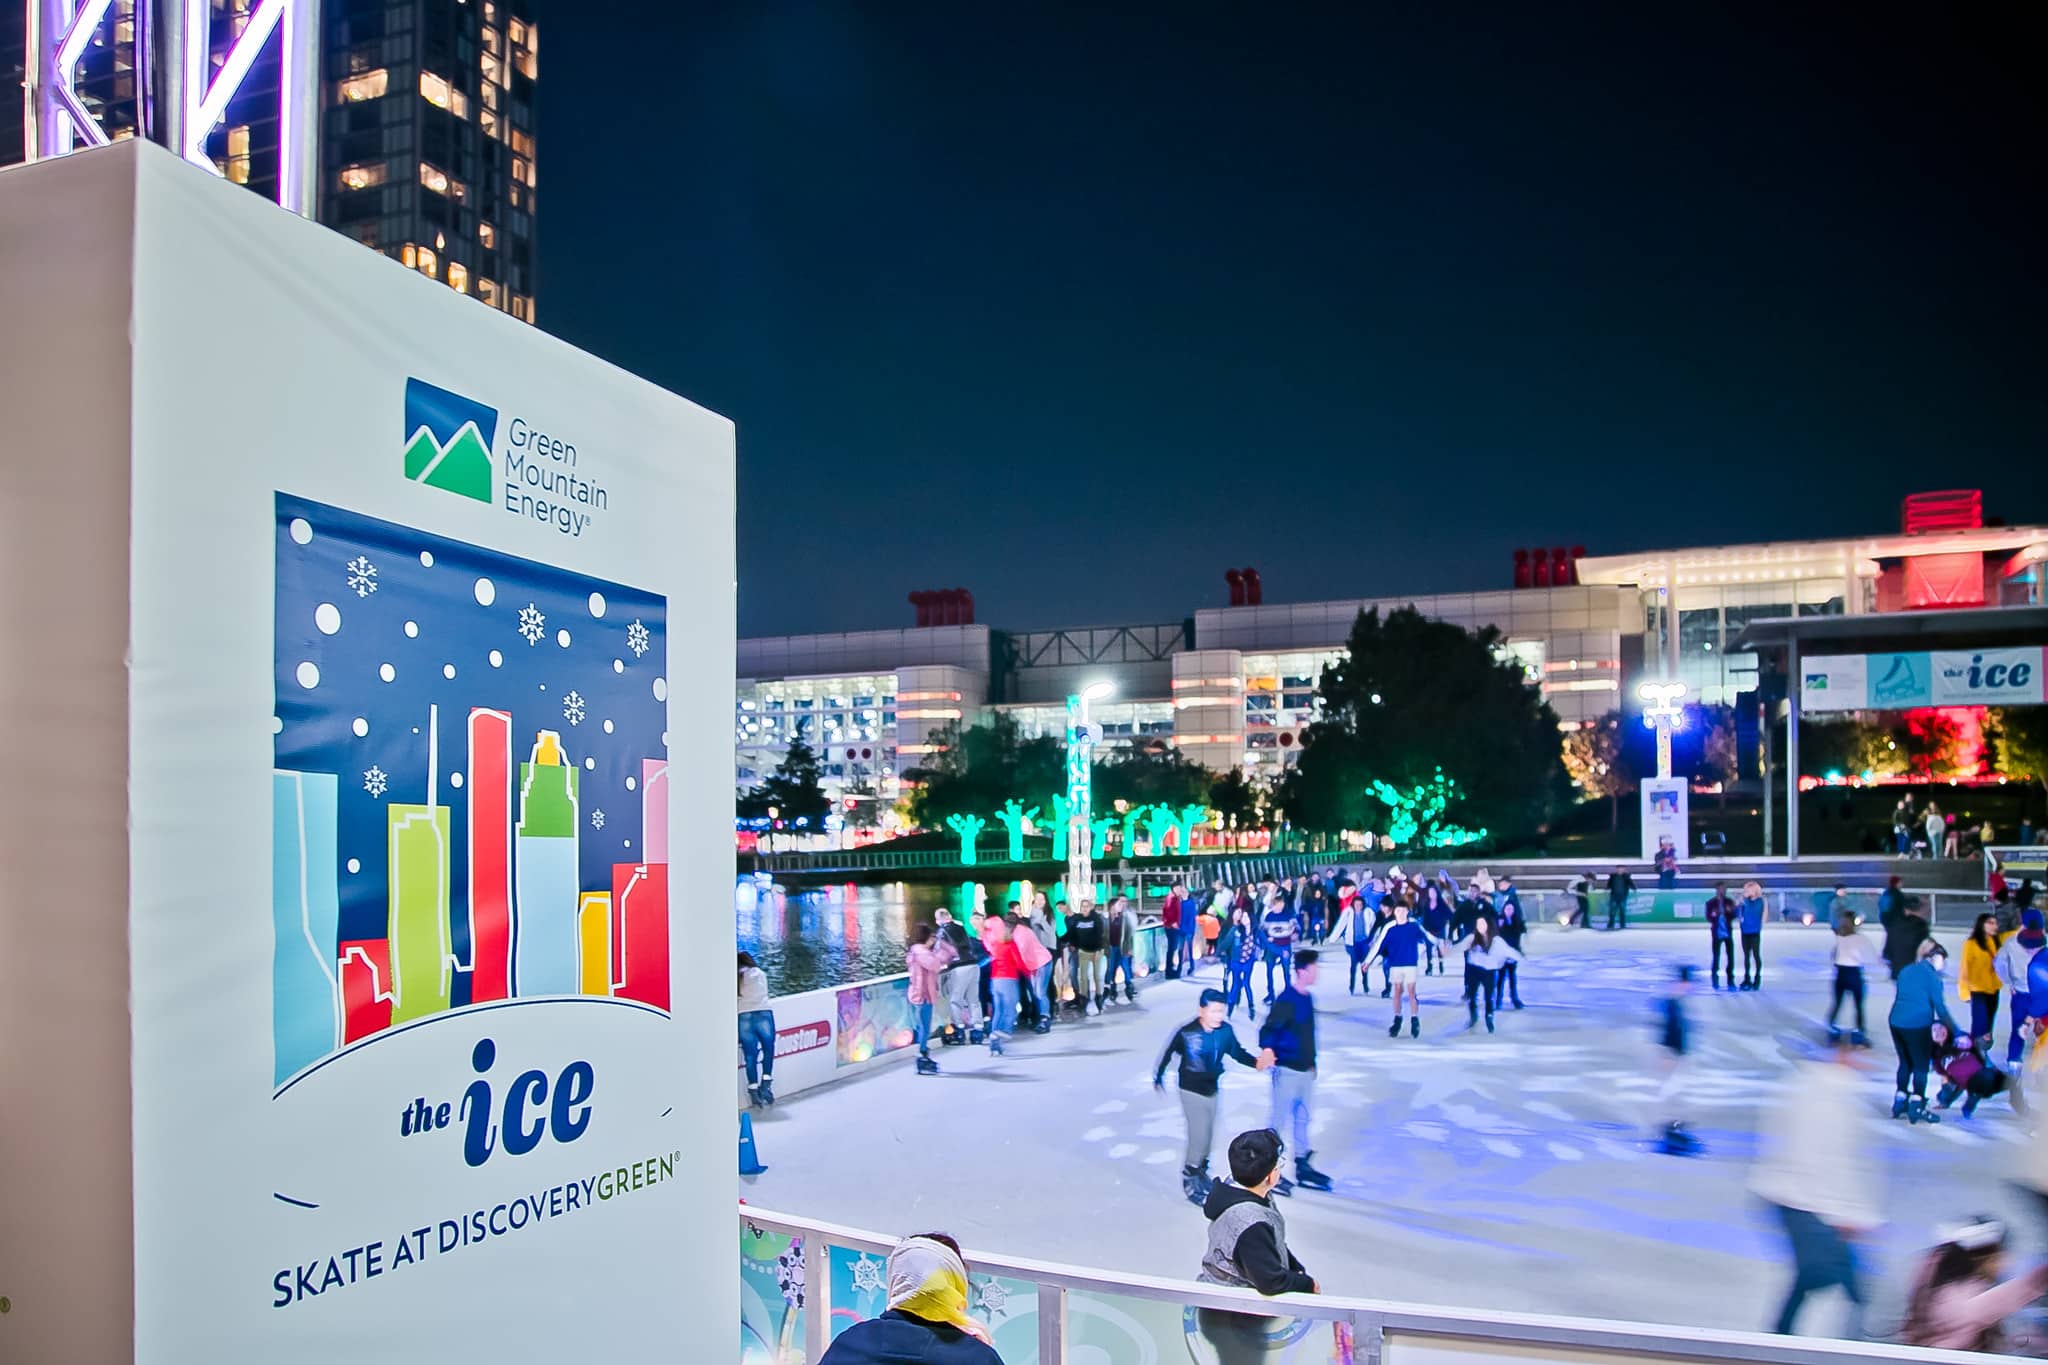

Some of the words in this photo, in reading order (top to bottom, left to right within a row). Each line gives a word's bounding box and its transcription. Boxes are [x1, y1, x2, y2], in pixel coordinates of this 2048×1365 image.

[509, 417, 577, 467] Green
[505, 449, 608, 510] Mountain
[1966, 654, 2031, 689] ice
[401, 1098, 450, 1137] the
[459, 1038, 594, 1167] ice
[273, 1241, 384, 1308] SKATE
[392, 1227, 432, 1271] AT
